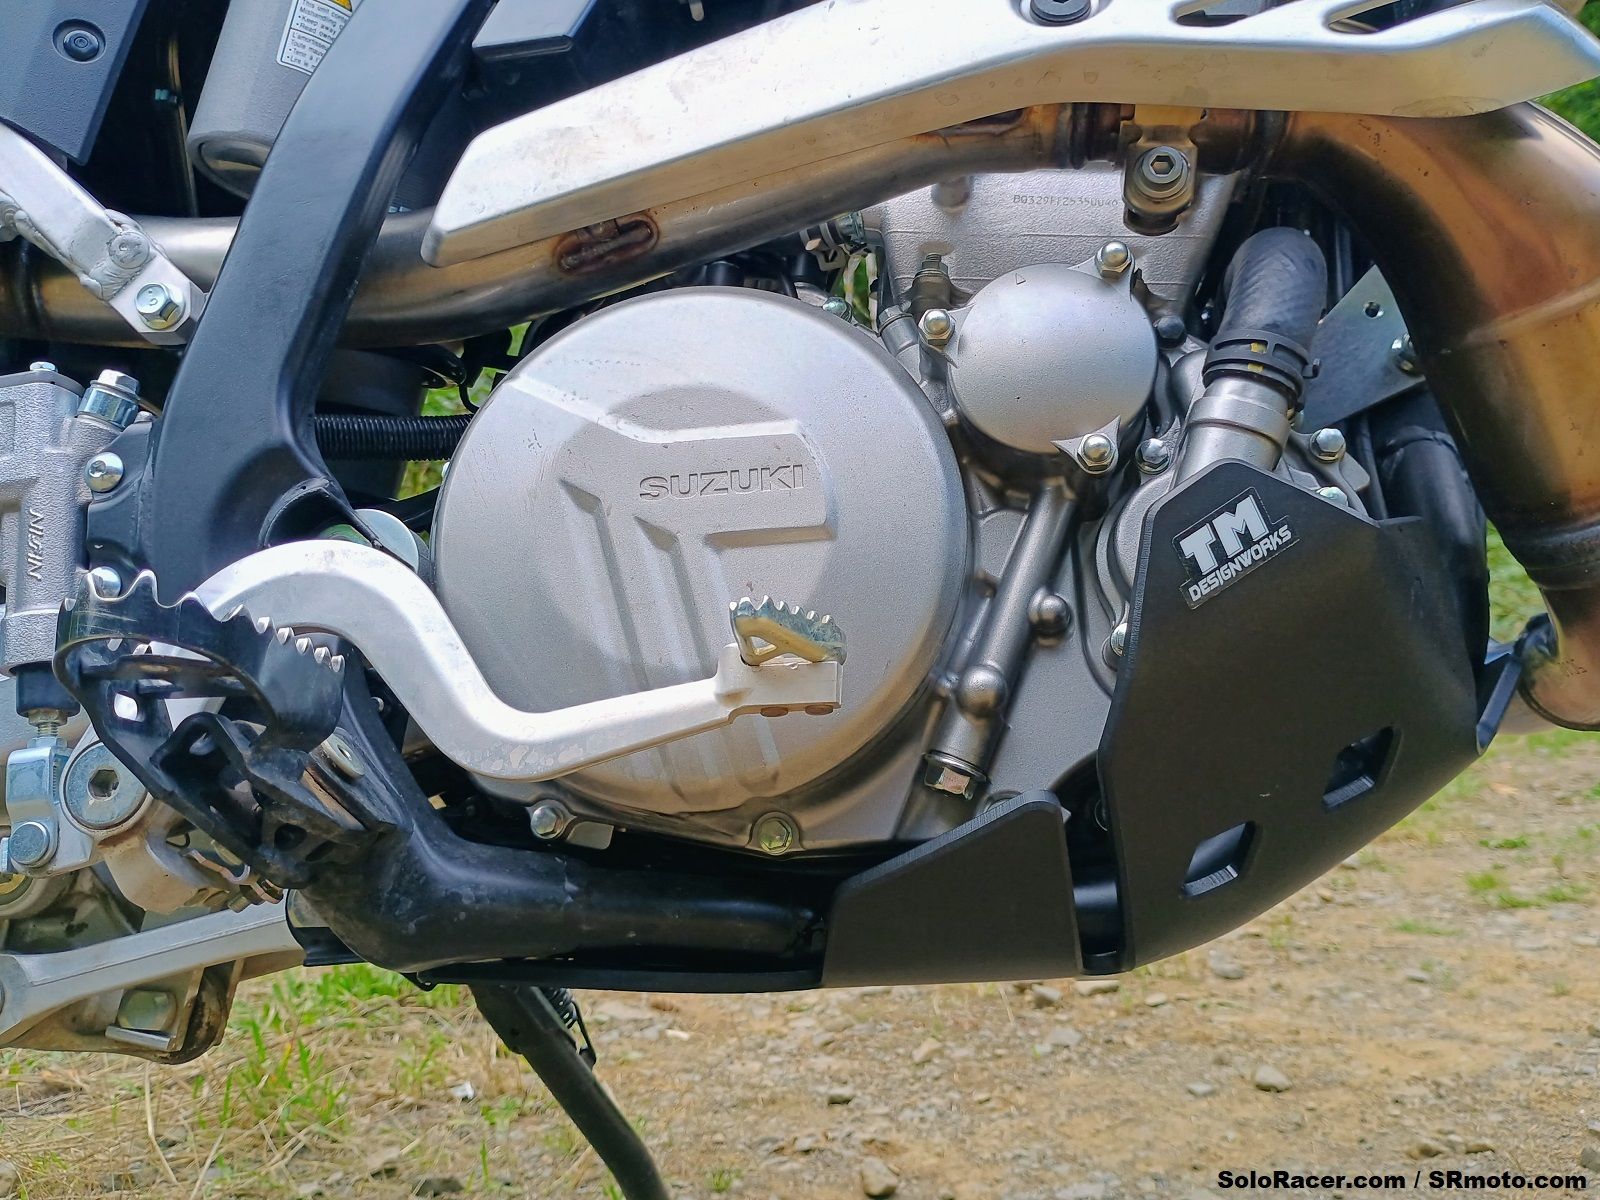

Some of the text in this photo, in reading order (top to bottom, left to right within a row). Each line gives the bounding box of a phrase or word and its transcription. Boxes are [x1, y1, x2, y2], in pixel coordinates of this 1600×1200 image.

[640, 464, 804, 500] SUZUKI
[1180, 495, 1270, 576] TM
[1188, 524, 1292, 602] DESIGNWORKS
